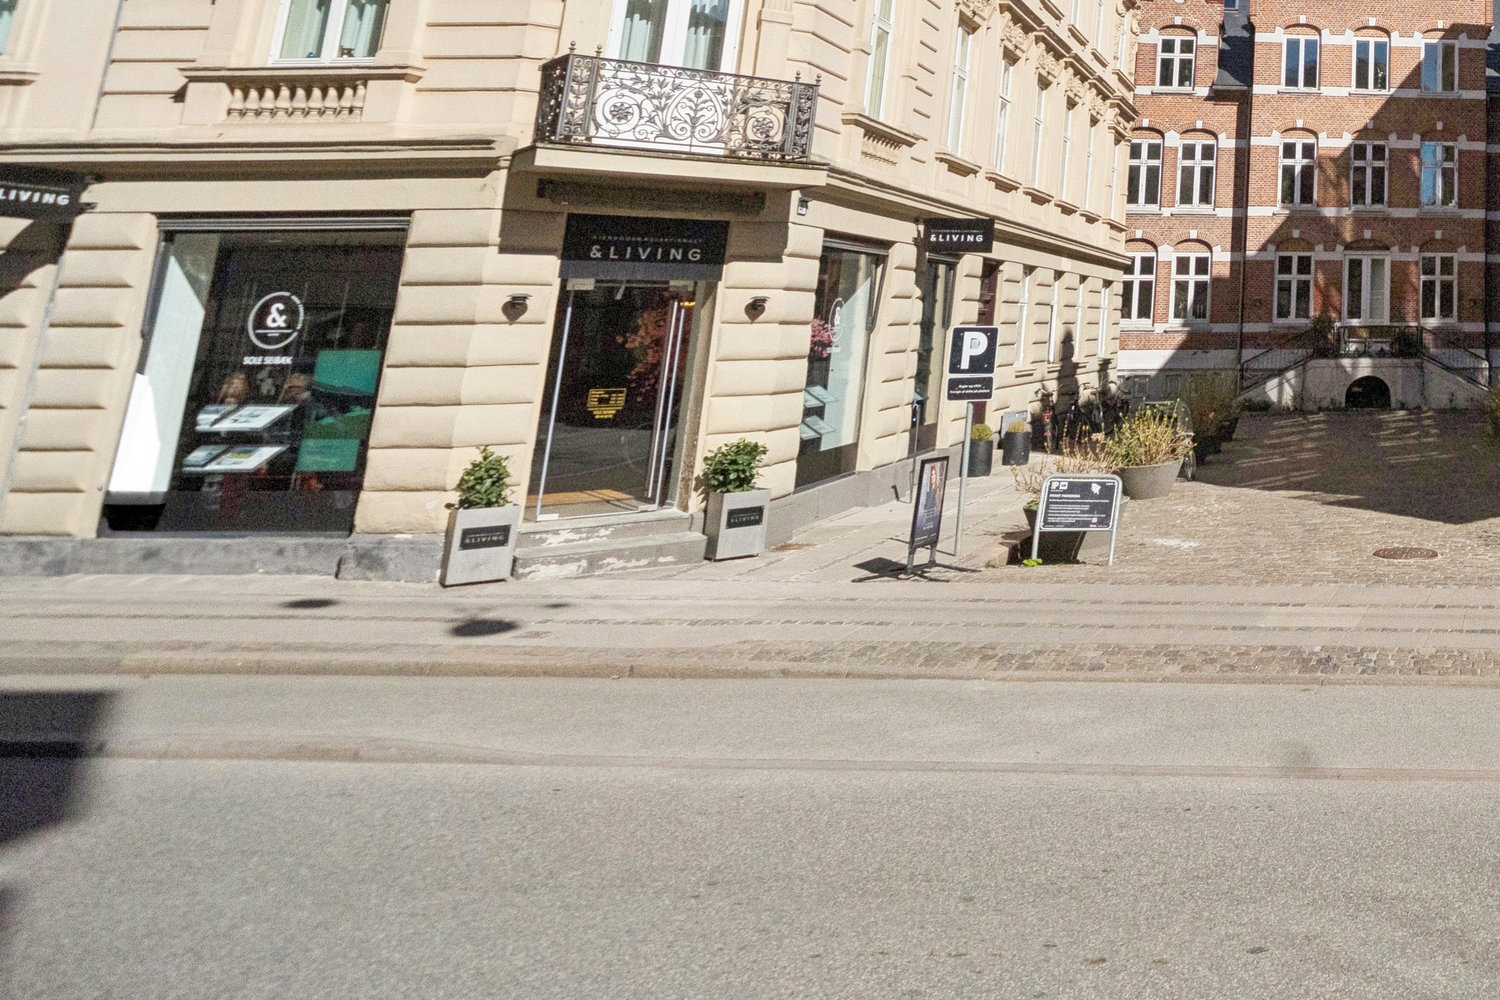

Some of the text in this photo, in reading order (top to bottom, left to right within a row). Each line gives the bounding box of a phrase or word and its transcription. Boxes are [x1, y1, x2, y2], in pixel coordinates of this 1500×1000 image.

[930, 234, 984, 242] &LIVING
[590, 245, 701, 261] &LIVING
[960, 331, 988, 370] P
